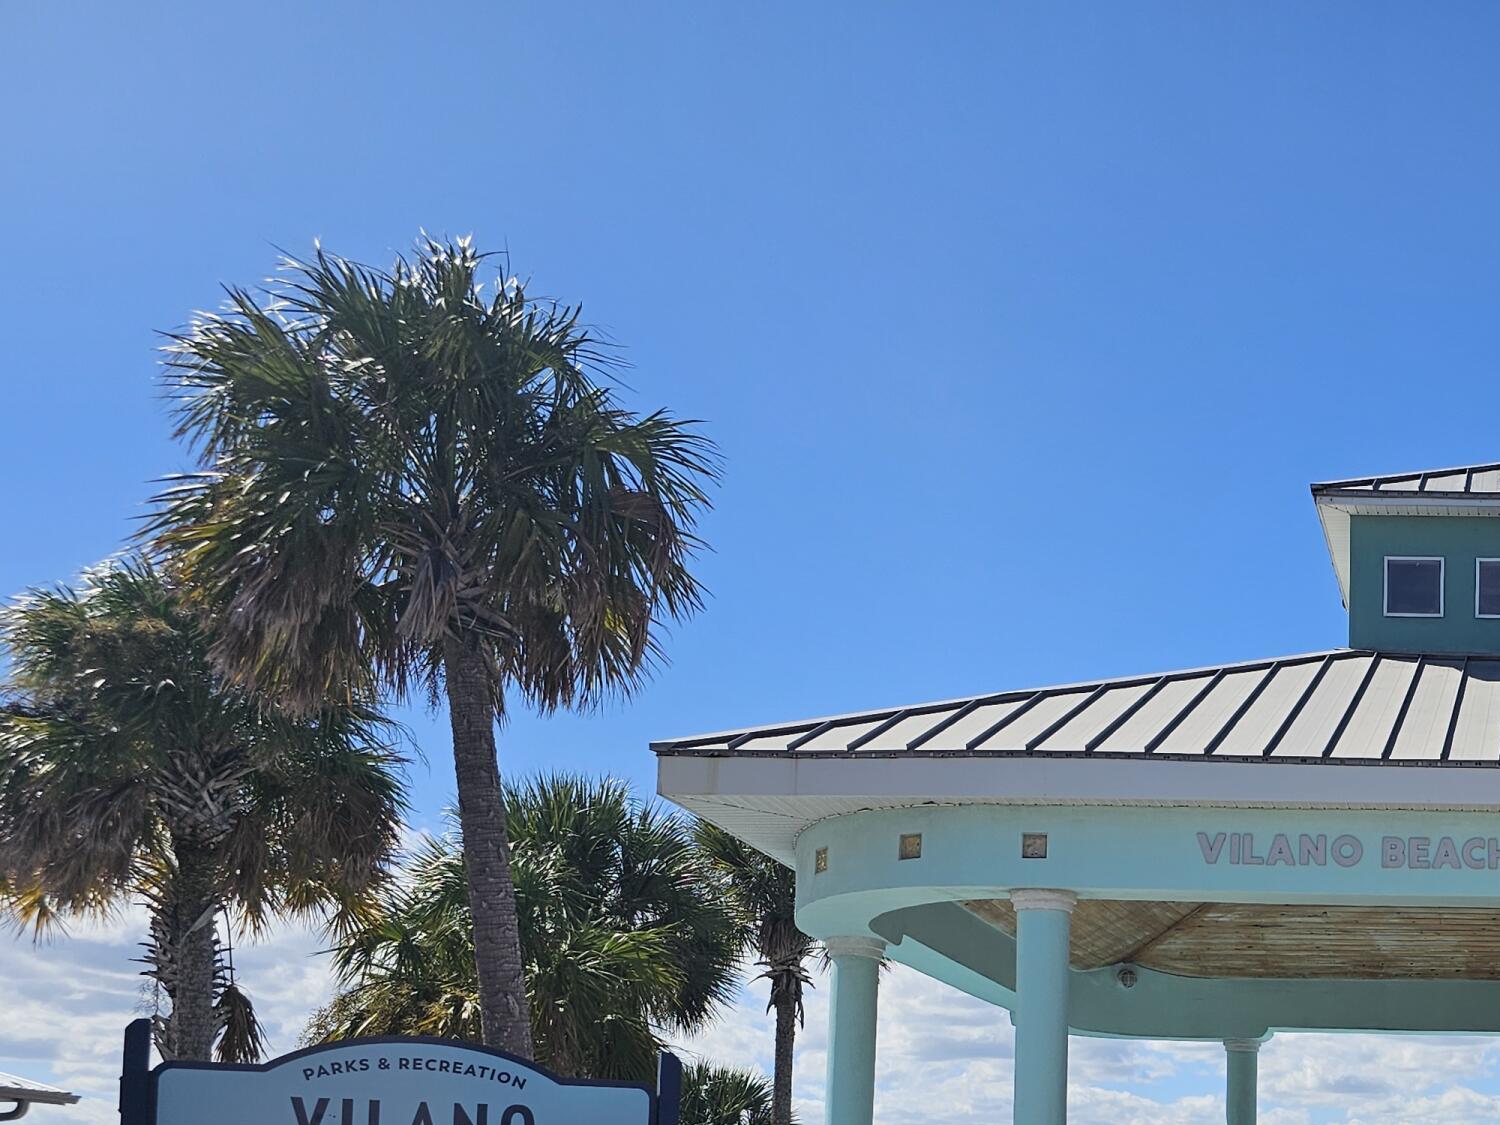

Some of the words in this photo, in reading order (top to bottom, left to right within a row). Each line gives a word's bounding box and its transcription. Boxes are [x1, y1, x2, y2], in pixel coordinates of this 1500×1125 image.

[1196, 832, 1364, 867] VILANO
[302, 1058, 370, 1081] PARKS
[377, 1057, 391, 1070] &
[398, 1057, 528, 1090] RECREATION
